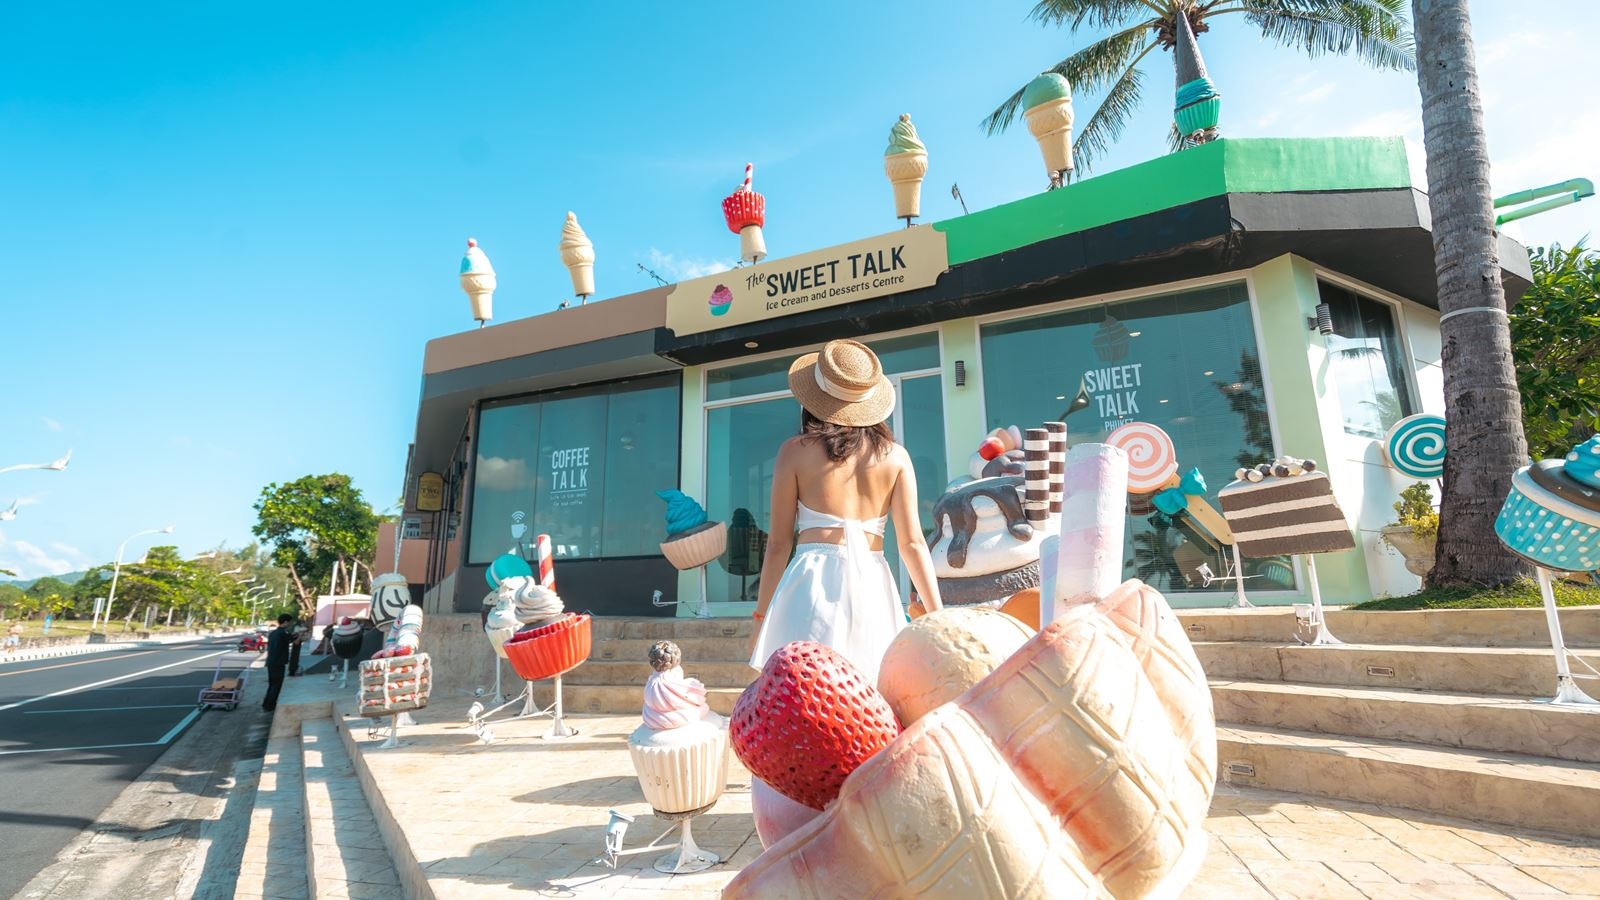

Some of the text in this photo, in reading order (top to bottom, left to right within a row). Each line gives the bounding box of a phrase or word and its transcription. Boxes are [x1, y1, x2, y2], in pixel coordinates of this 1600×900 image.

[745, 245, 906, 297] The SWEET TALK
[766, 275, 905, 311] Ice Cream and Desserts Centre
[1084, 363, 1142, 393] SWEET
[1095, 390, 1140, 418] TALK
[552, 447, 590, 469] COFFEE
[552, 468, 588, 490] TALK
